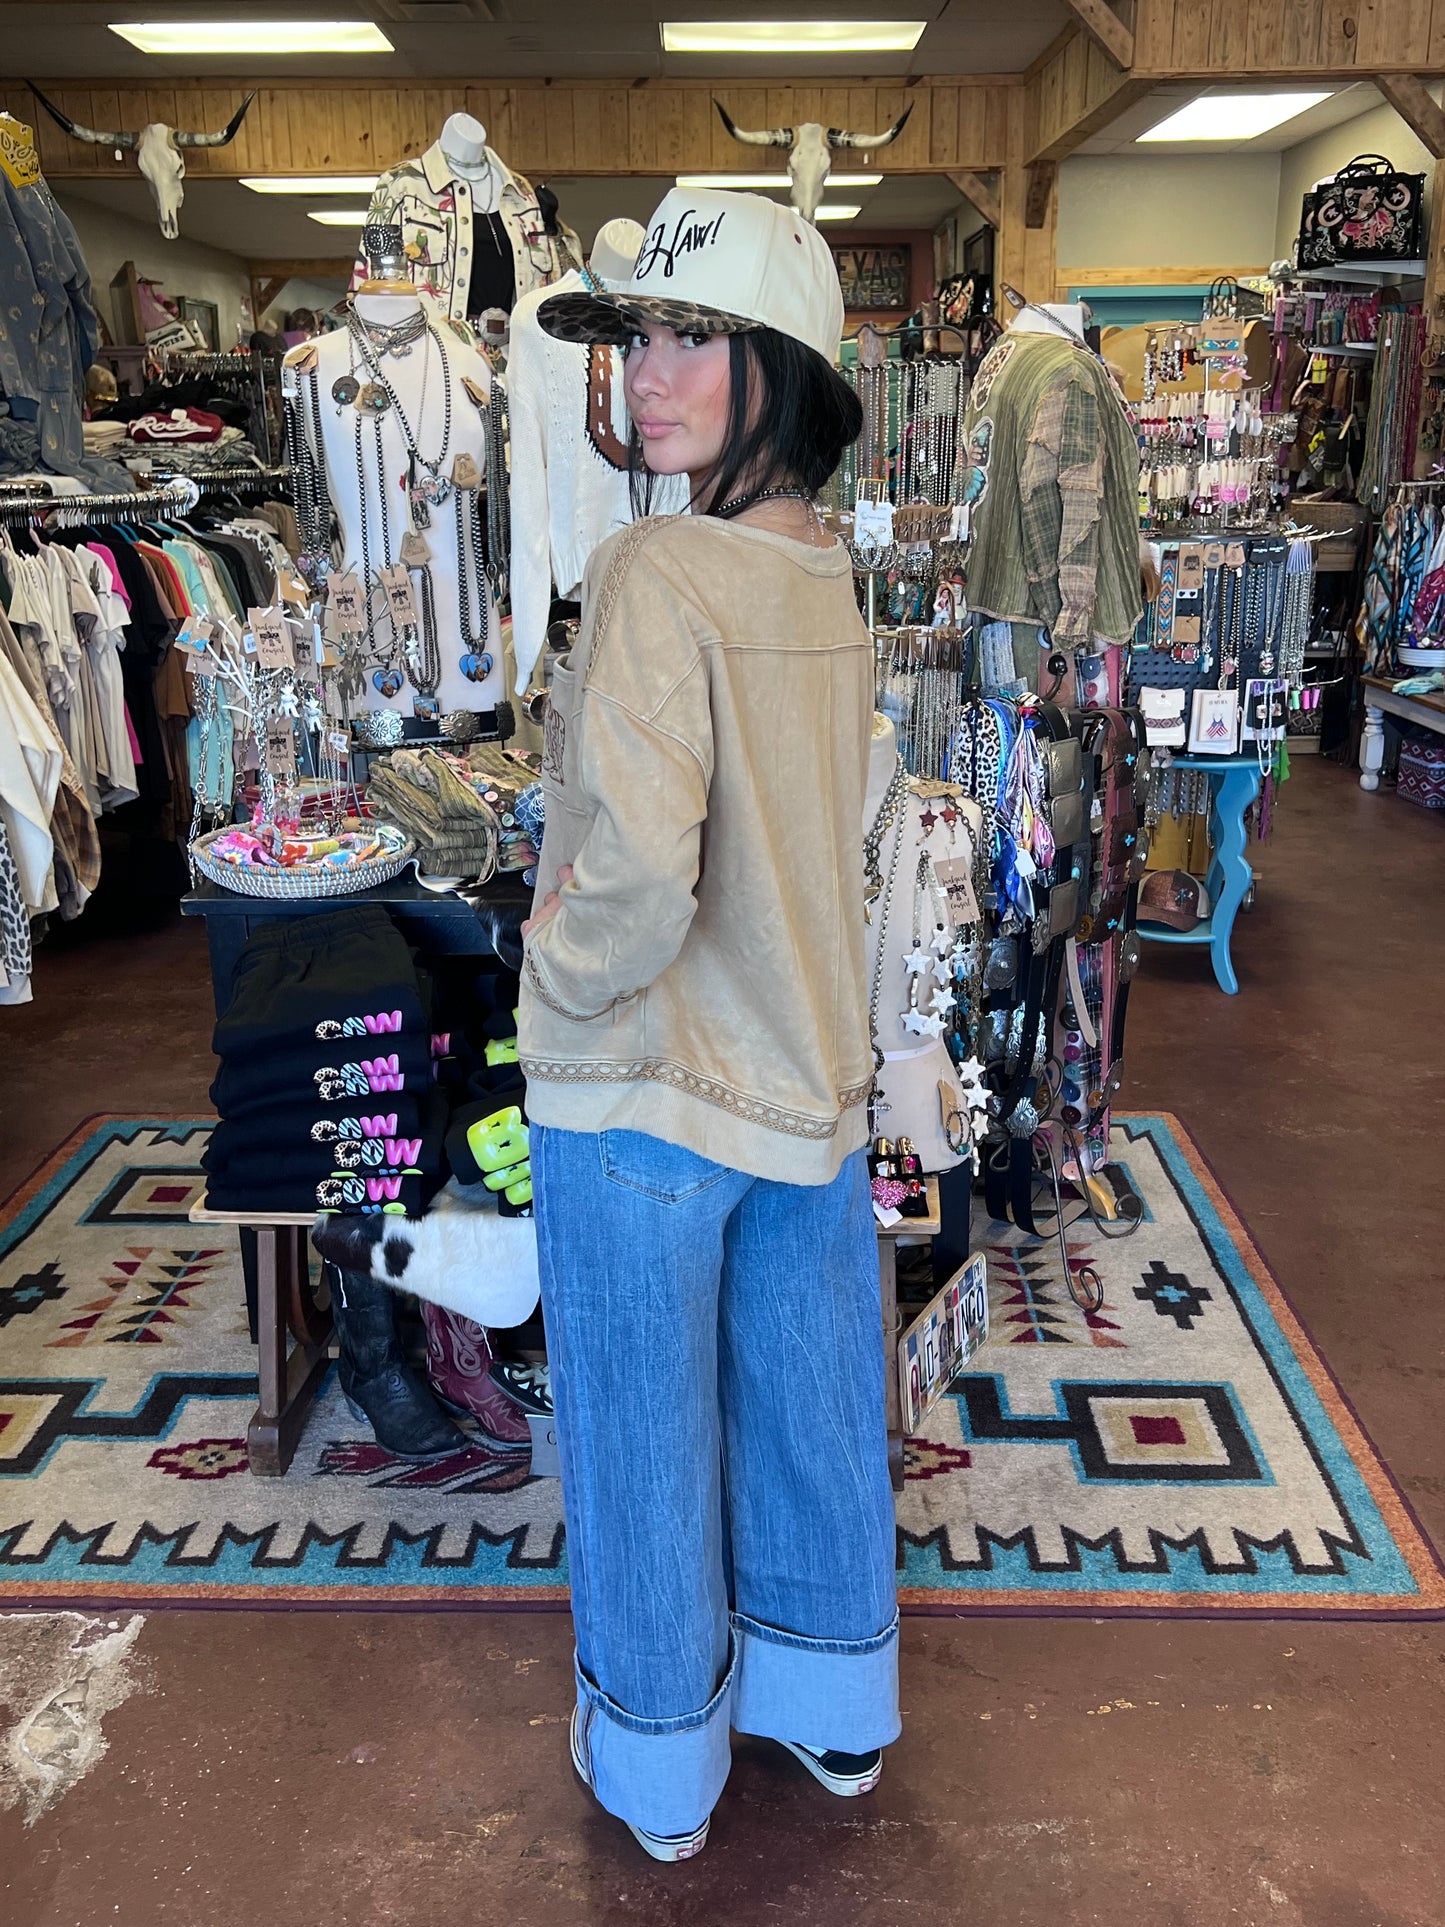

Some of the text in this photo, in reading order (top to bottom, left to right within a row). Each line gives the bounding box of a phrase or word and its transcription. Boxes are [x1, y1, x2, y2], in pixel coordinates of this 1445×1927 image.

[835, 251, 905, 293] EXAS
[268, 728, 290, 738] unkyard
[334, 1138, 423, 1168] COW
[316, 1175, 404, 1207] COW
